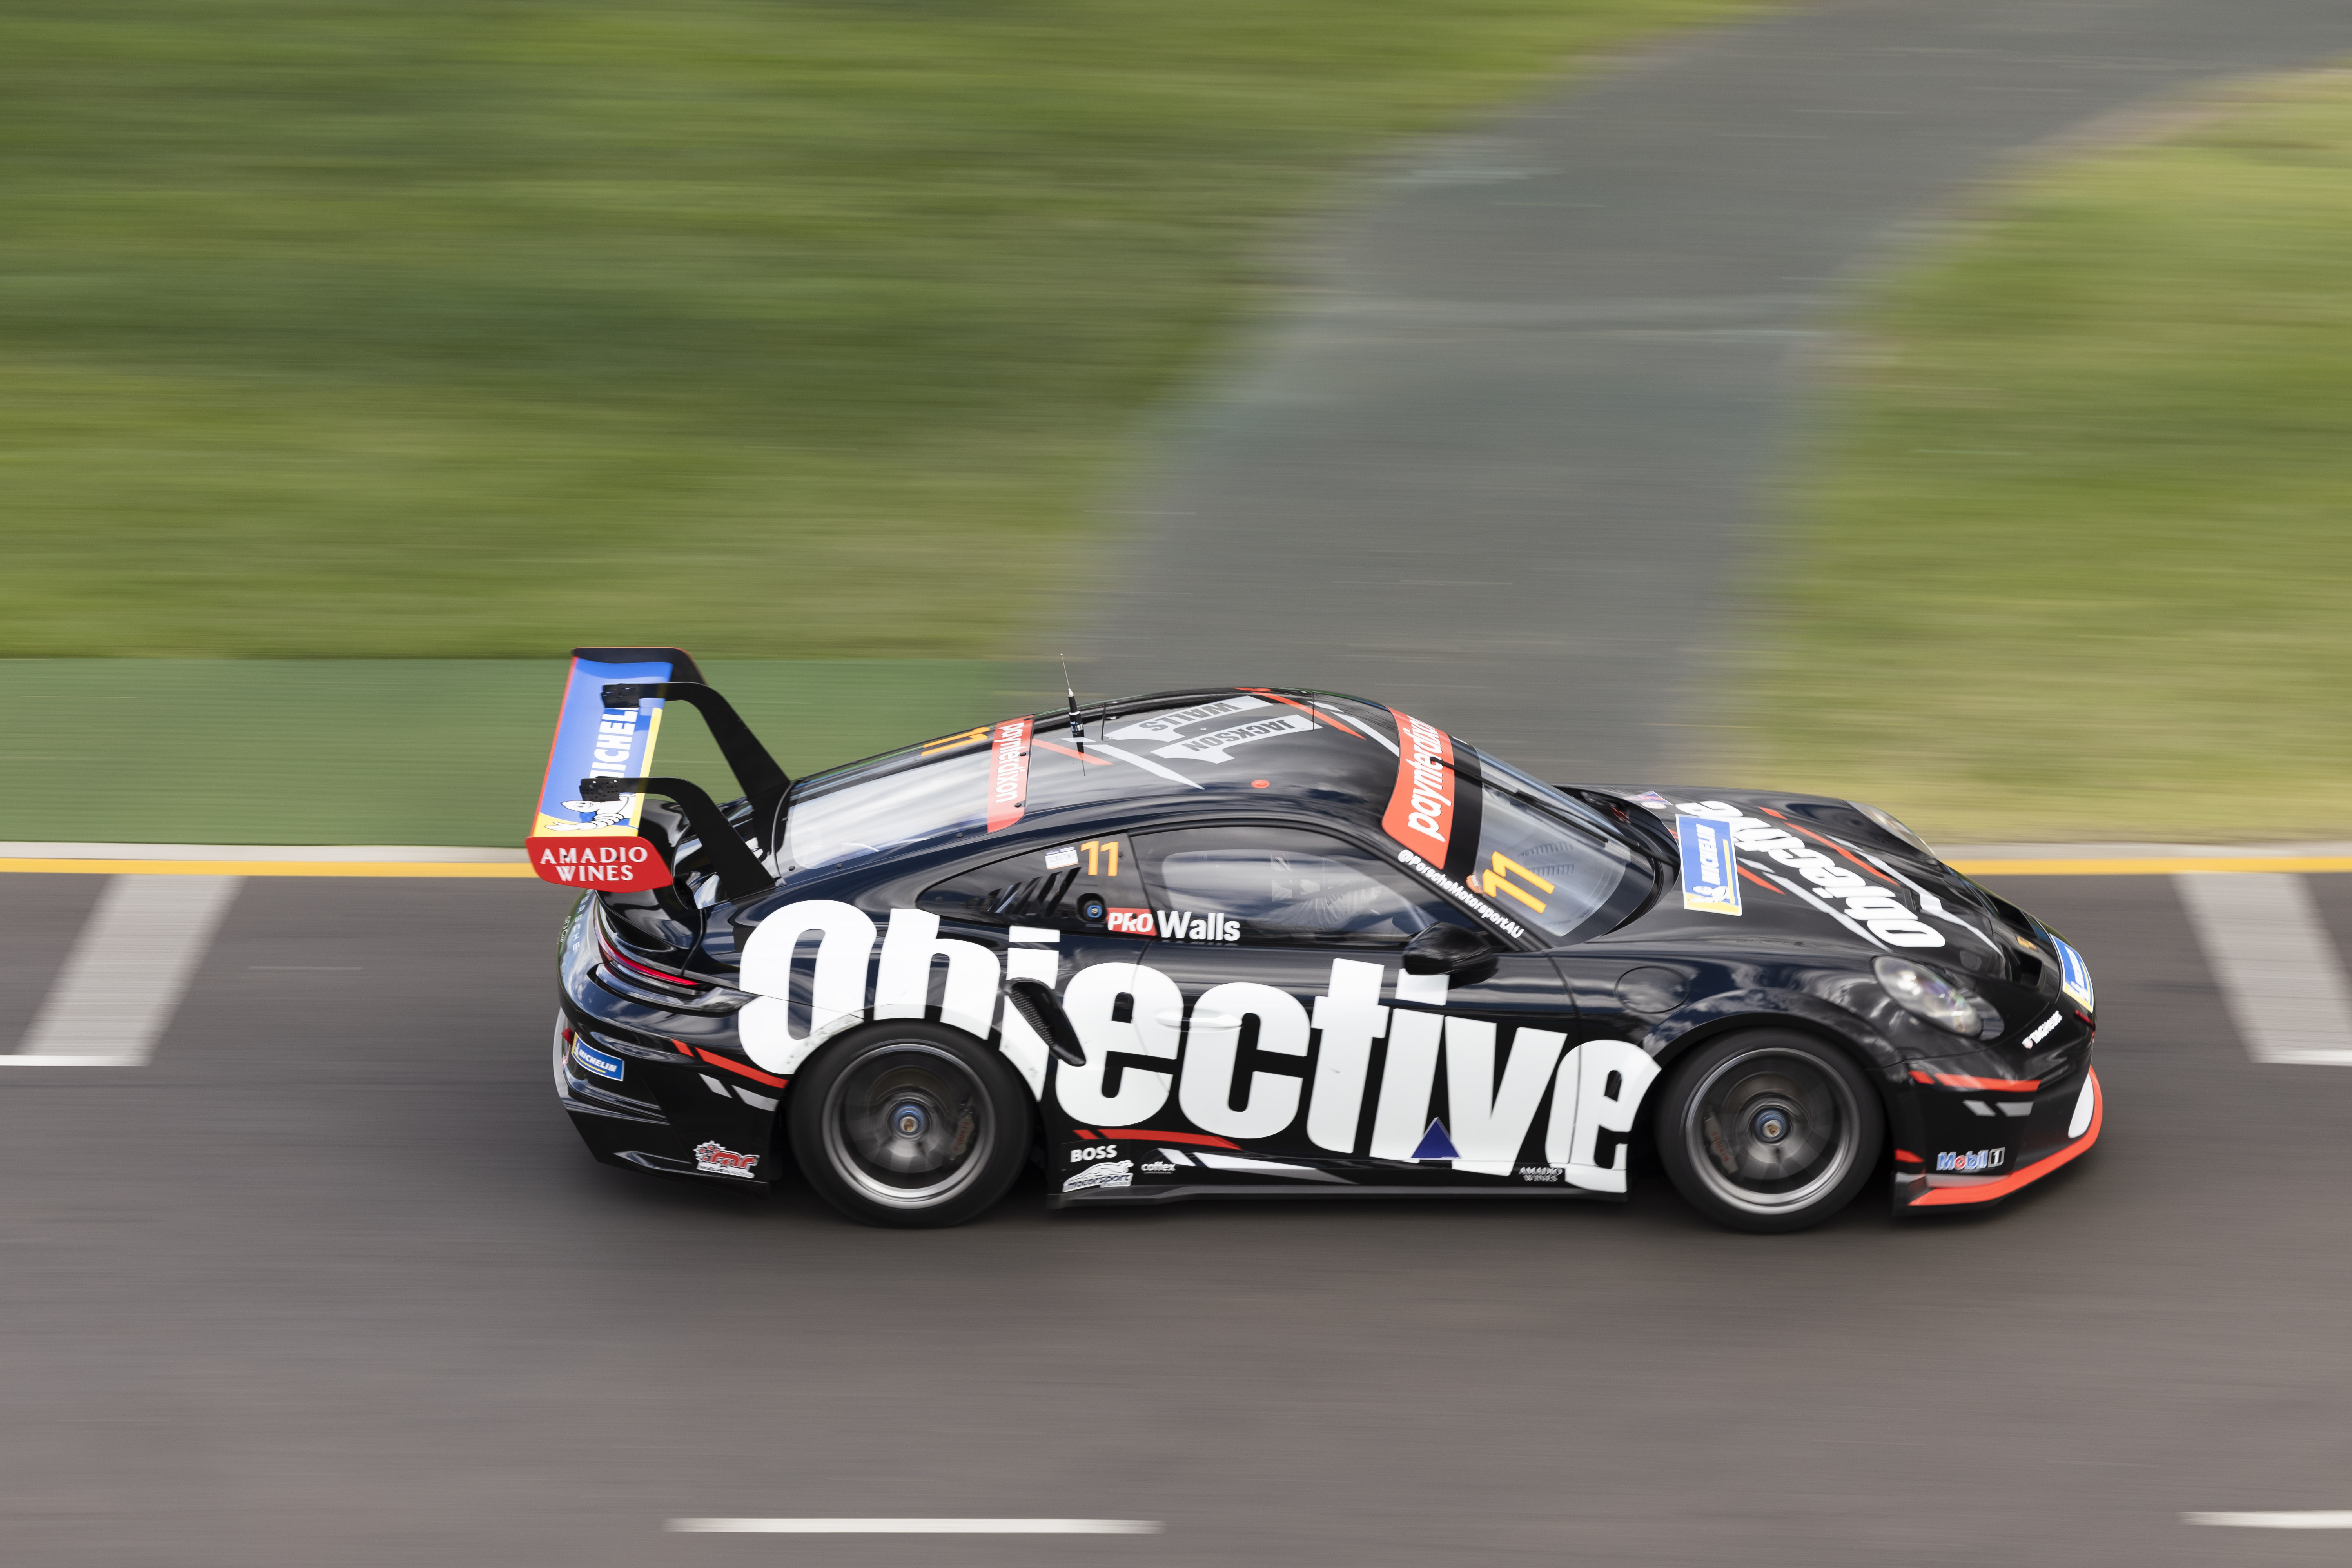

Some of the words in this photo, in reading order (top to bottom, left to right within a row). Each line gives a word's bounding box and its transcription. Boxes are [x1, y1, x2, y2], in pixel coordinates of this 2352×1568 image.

[1138, 703, 1242, 731] WALLS
[921, 727, 990, 756] 11
[1183, 720, 1296, 751] JACKSON
[994, 722, 1027, 803] paynterdixon
[540, 846, 648, 864] AMADIO
[1081, 840, 1119, 876] 11
[1696, 823, 1720, 886] MICHELIN
[555, 865, 634, 882] WINES
[1482, 851, 1555, 914] 11
[1397, 849, 1524, 939] @PorscheMotorsportAU
[1107, 912, 1154, 932] PRO
[1157, 910, 1241, 941] Walls
[579, 1049, 617, 1072] MICHELIN
[1070, 1145, 1118, 1163] BOSS
[1141, 1161, 1176, 1171] coffex
[1936, 1149, 1989, 1171] Mobil
